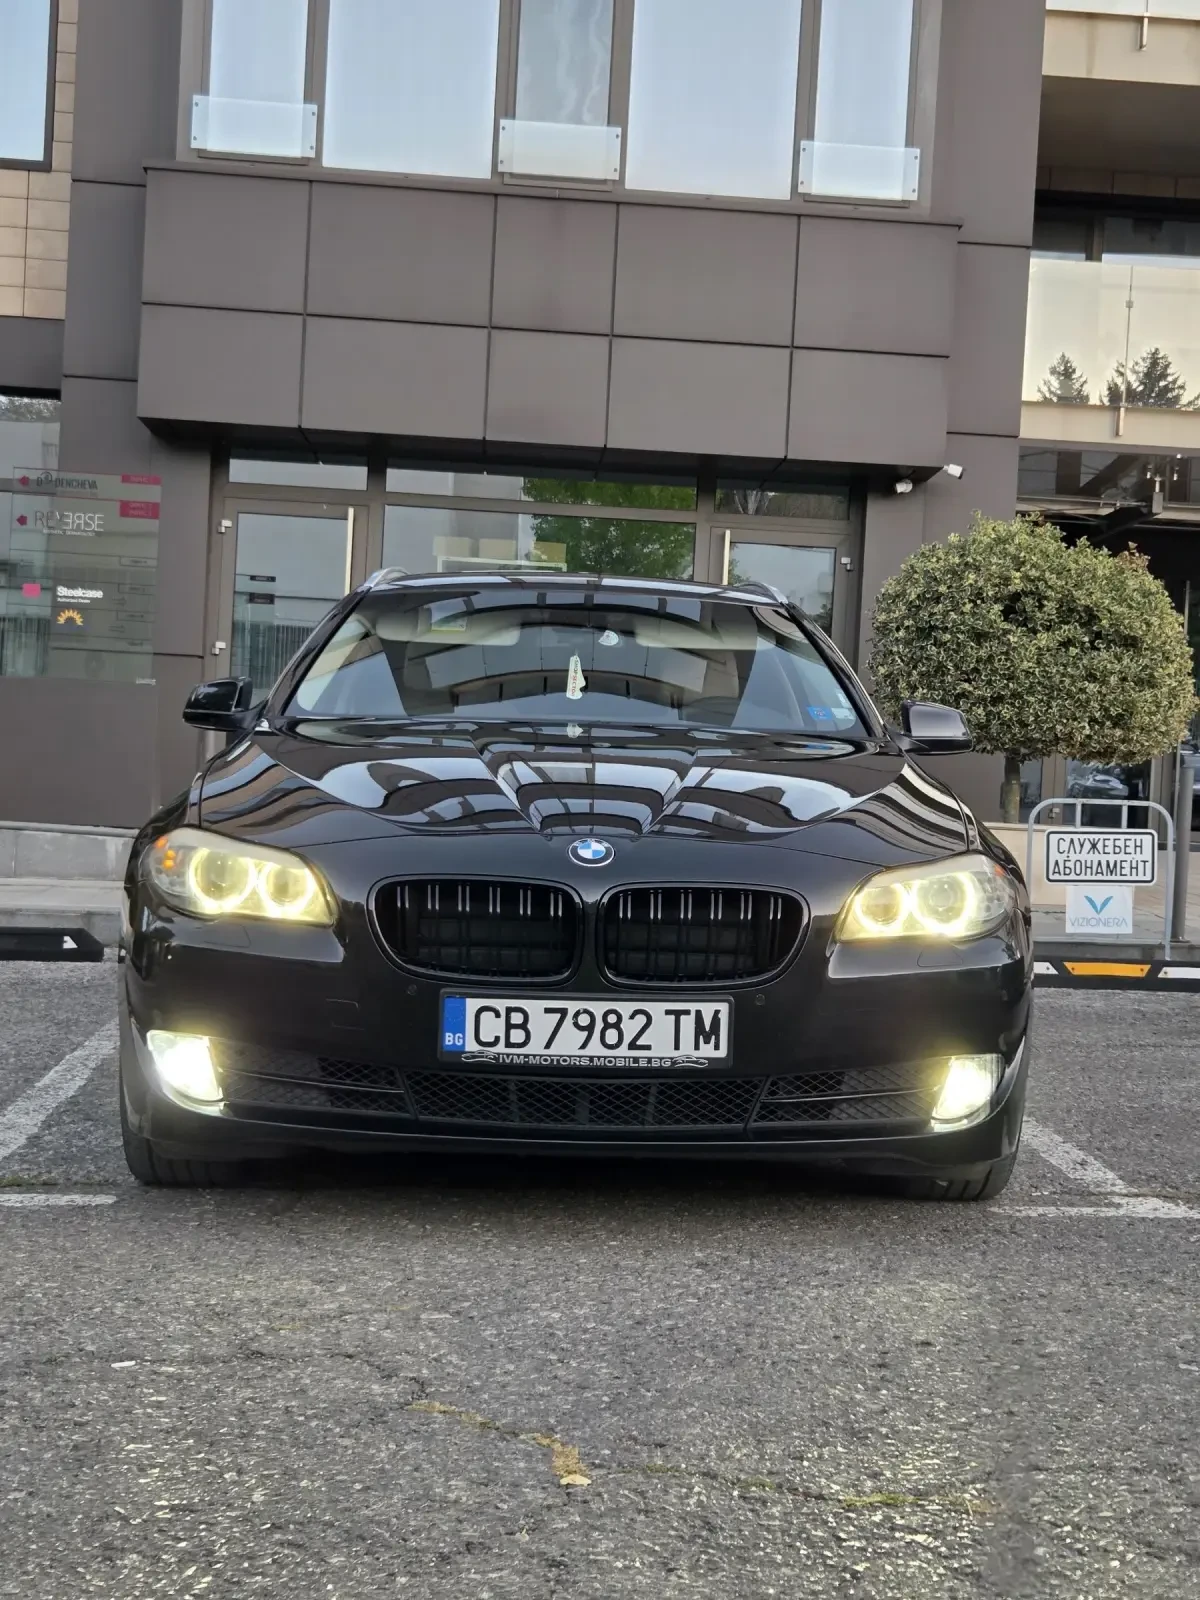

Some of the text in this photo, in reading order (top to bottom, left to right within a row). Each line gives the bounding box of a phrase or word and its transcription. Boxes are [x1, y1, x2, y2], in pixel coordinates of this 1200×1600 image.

[56, 585, 104, 598] Steelcase
[1057, 837, 1143, 855] СЛУЖЕБЕН
[1052, 859, 1149, 877] АБОНАМЕНТ
[1069, 917, 1128, 928] VIZIONERA
[445, 1005, 722, 1051] BG CB 7982 TM
[499, 1054, 672, 1068] IVM-MOTORS.MOBILE.BG
